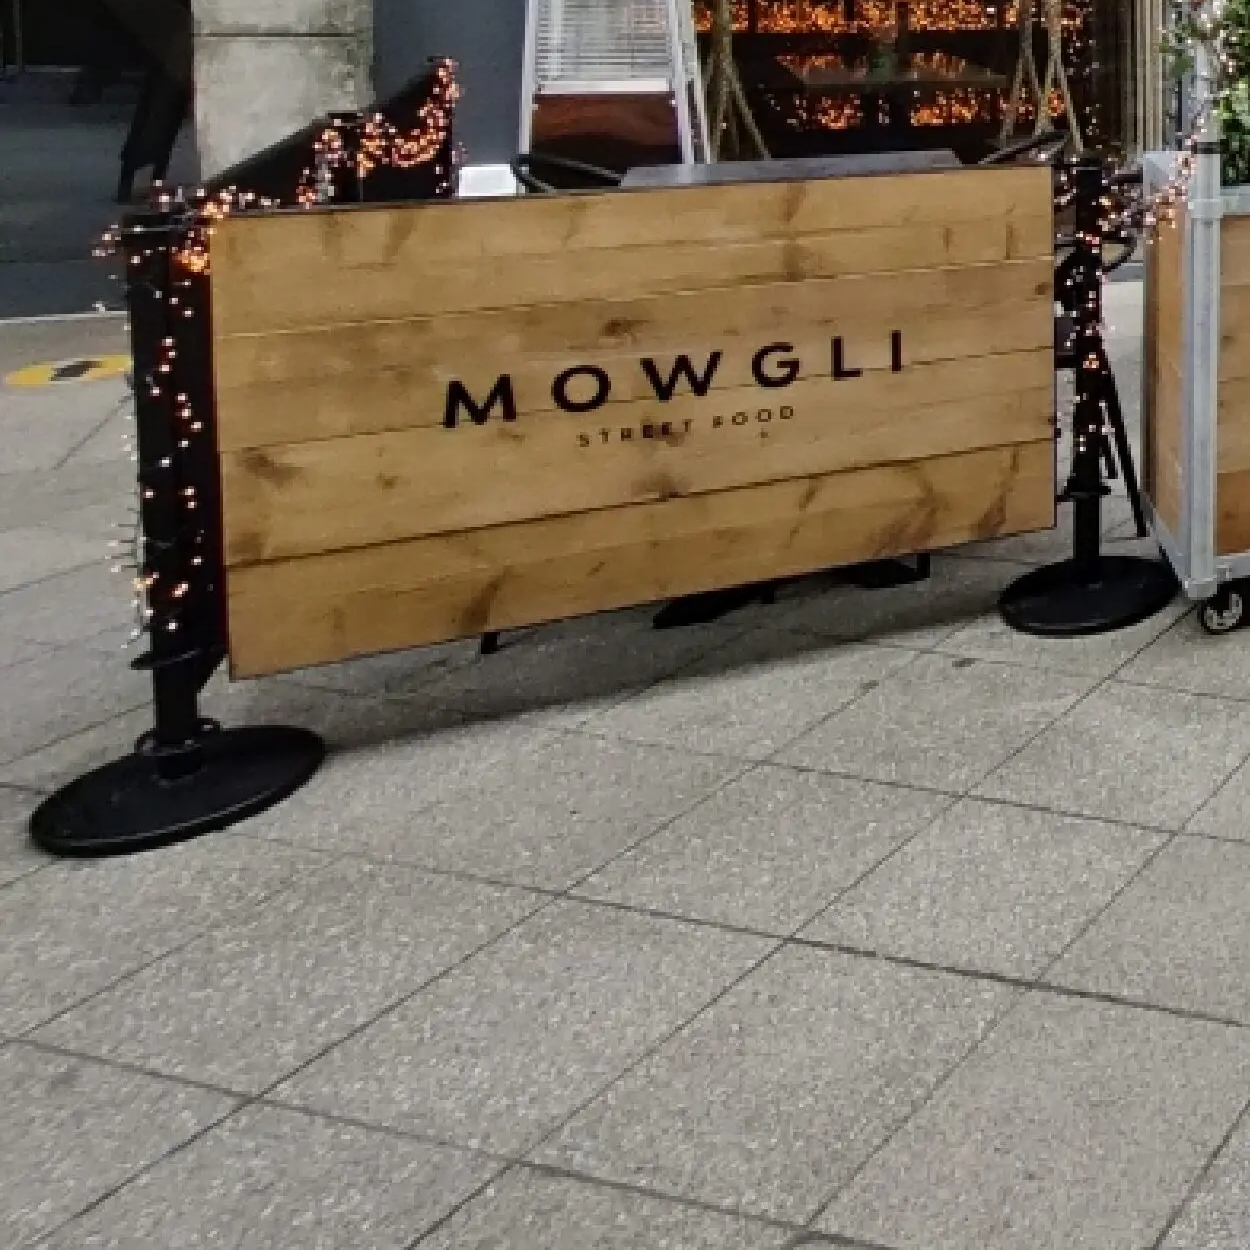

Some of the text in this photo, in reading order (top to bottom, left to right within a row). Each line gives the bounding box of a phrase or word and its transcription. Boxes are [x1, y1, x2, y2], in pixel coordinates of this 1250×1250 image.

[443, 329, 903, 429] MOWGLI
[577, 405, 794, 448] STREET FOOD
